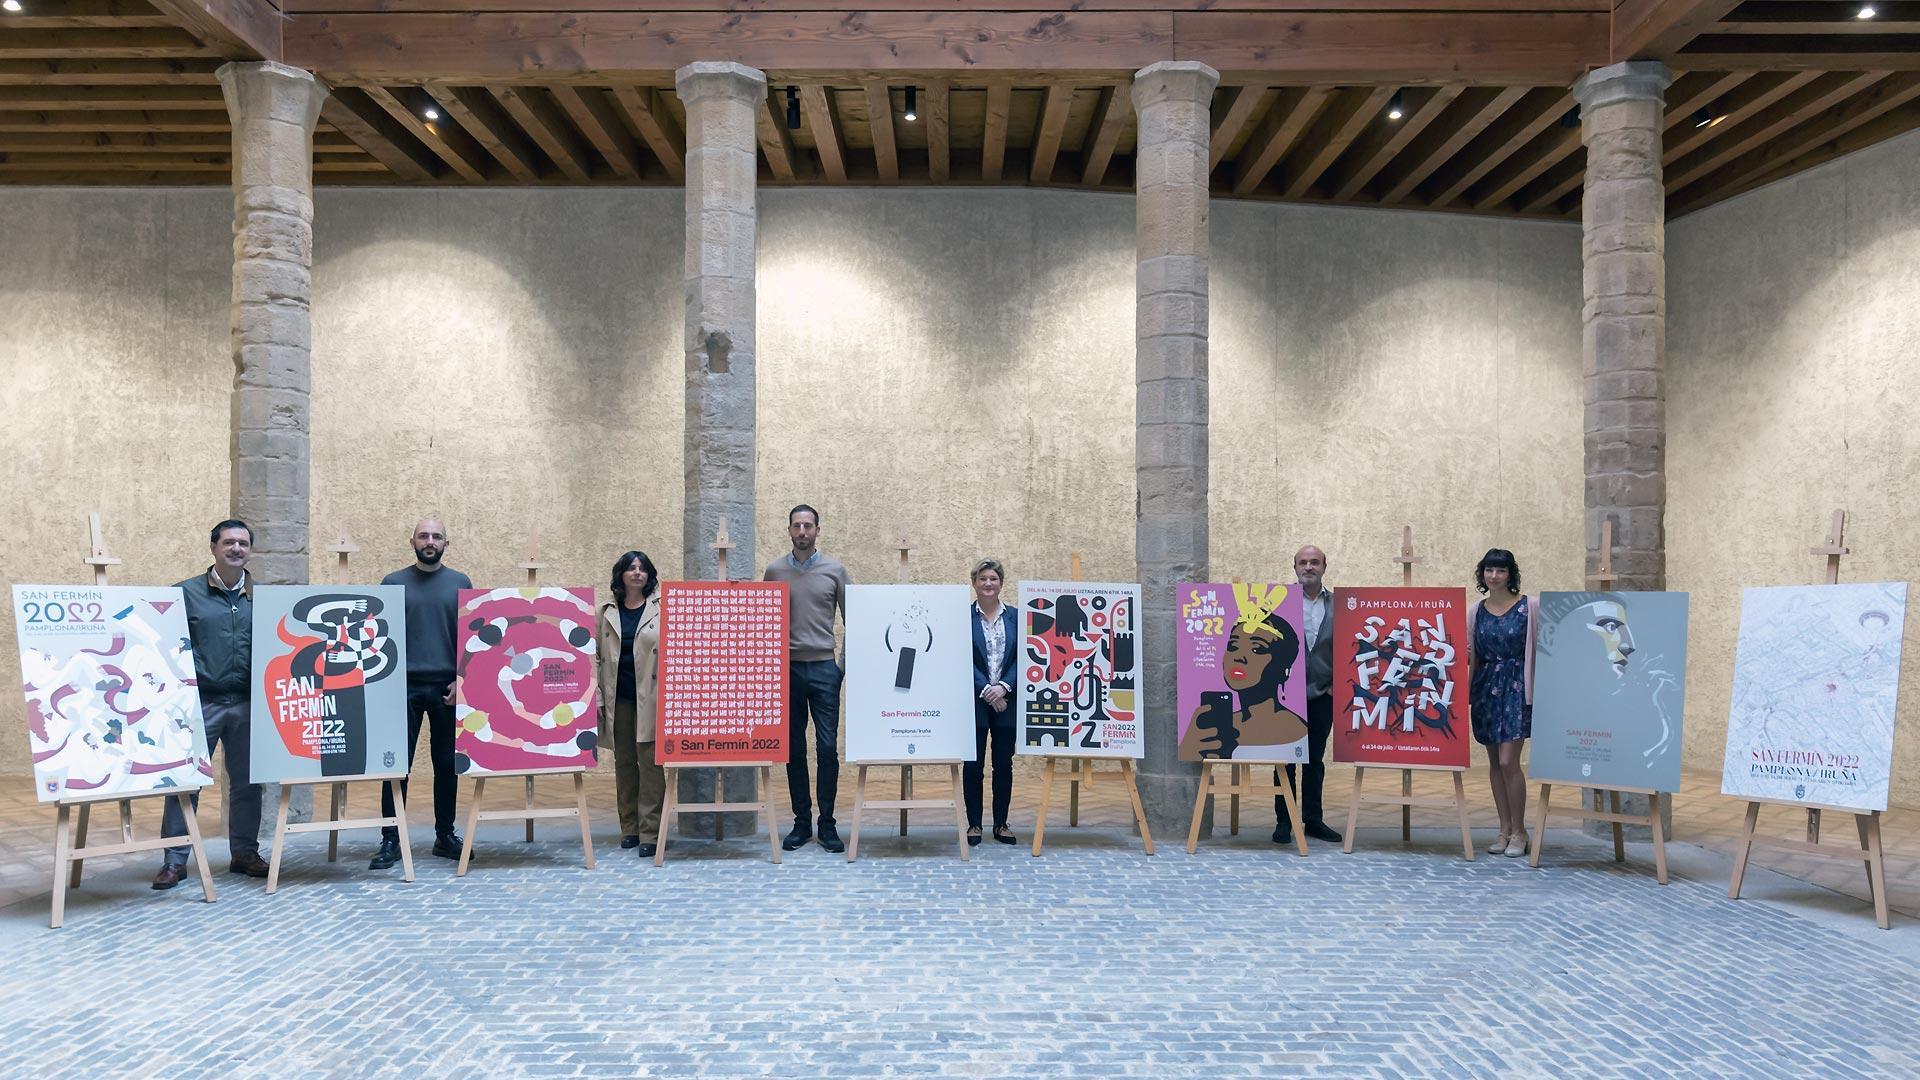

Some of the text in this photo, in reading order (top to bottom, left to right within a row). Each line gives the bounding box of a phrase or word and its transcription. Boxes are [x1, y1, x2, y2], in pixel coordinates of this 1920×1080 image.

[22, 591, 48, 600] SAN
[1190, 590, 1216, 607] SAN
[24, 602, 104, 622] 2022
[1186, 617, 1224, 635] 2022
[1355, 613, 1446, 648] SAN
[275, 676, 315, 700] SAN
[280, 693, 336, 722] FERMÍN
[302, 720, 346, 738] 2022
[681, 739, 780, 750] San Fermín 2022
